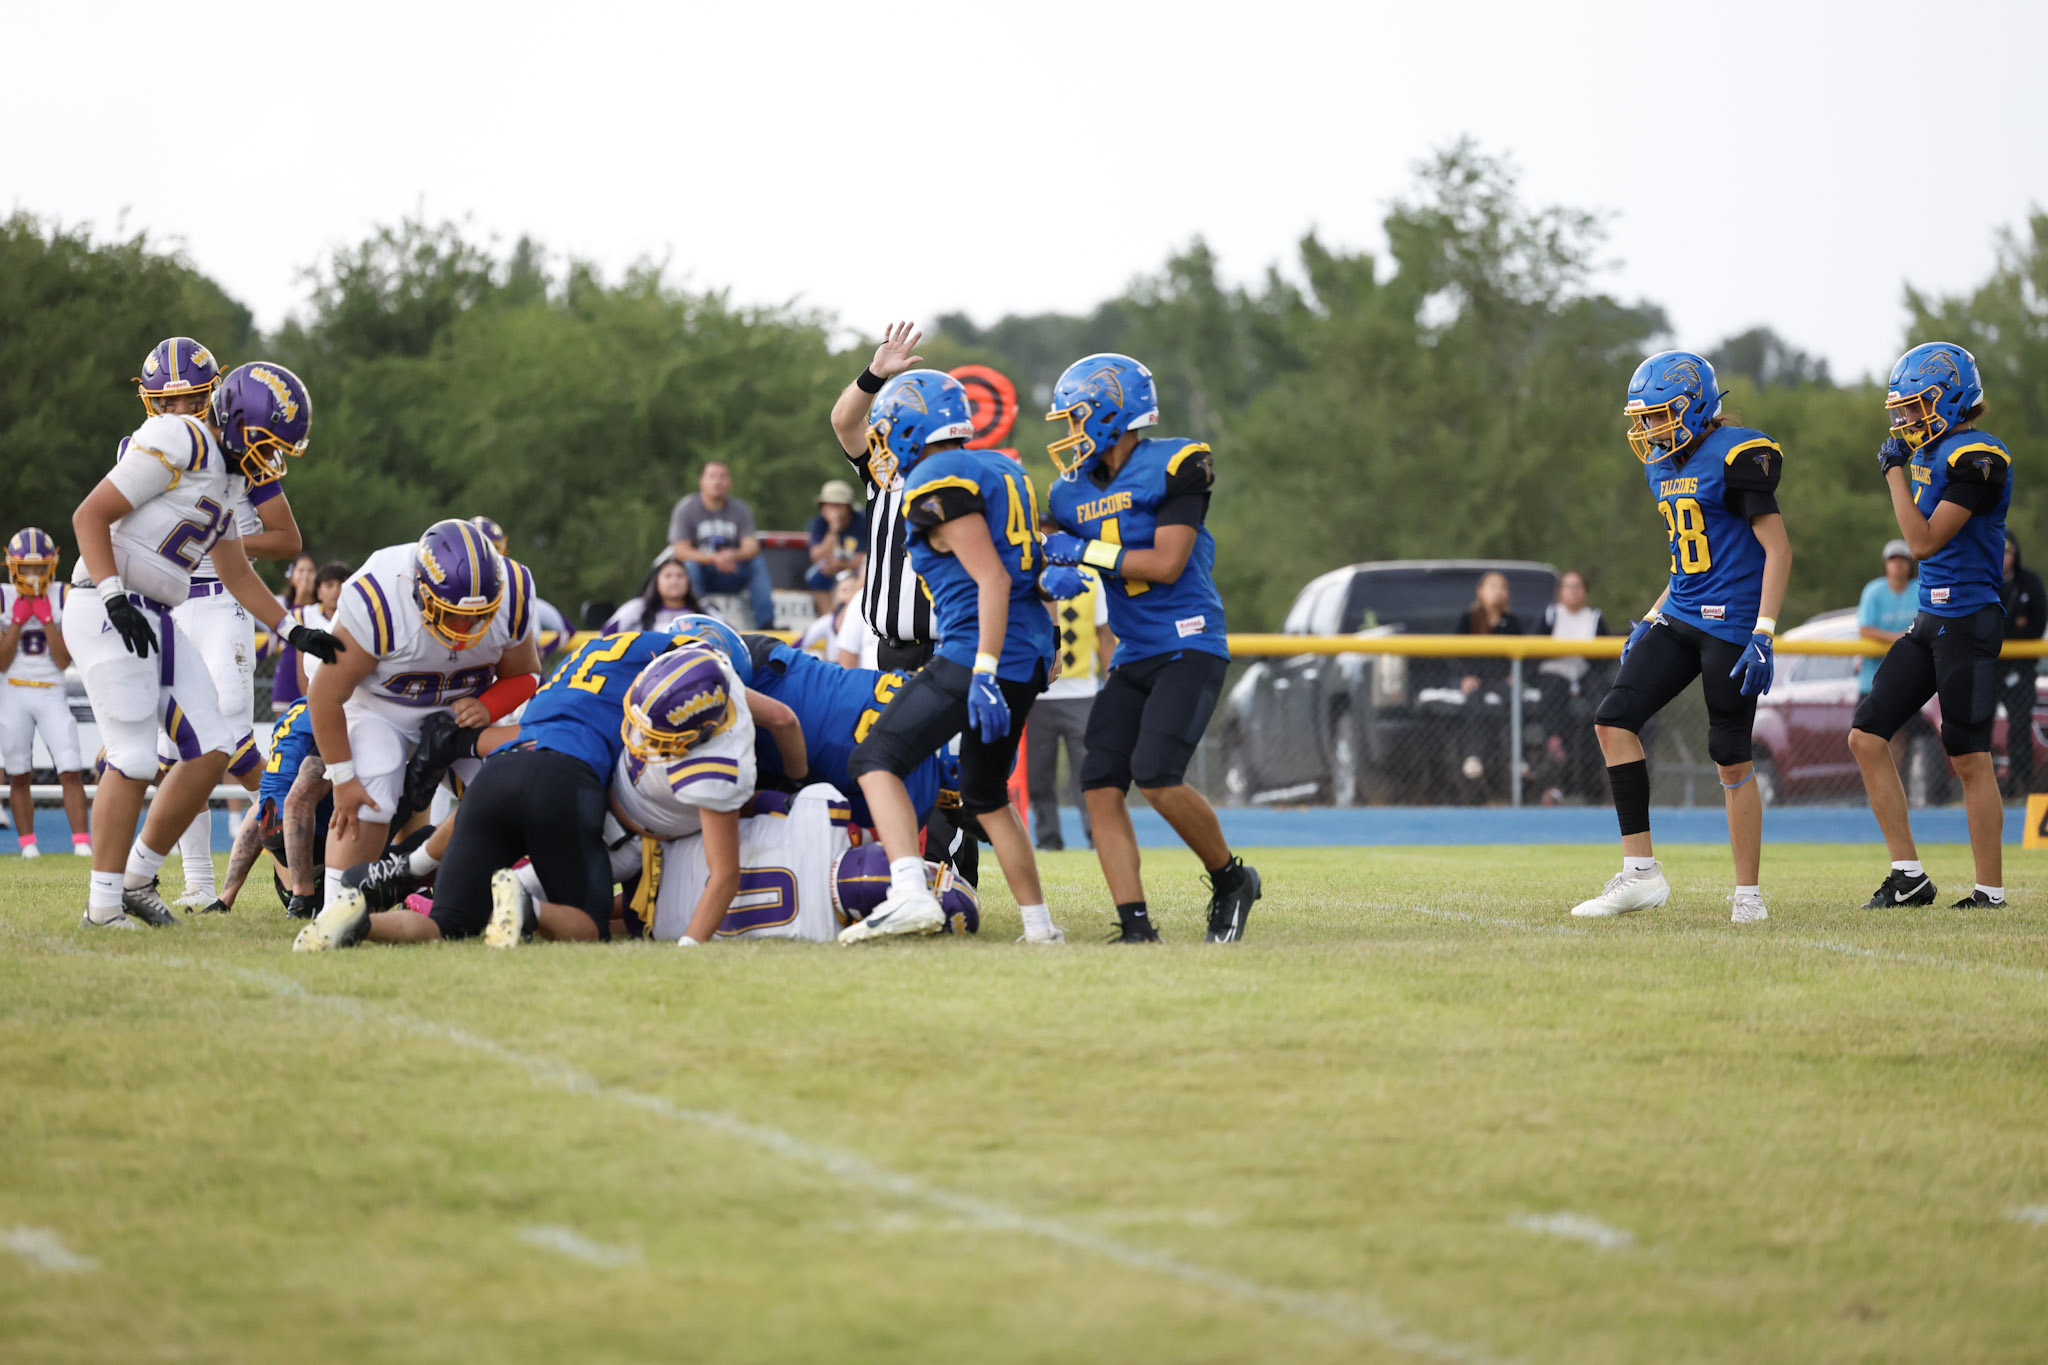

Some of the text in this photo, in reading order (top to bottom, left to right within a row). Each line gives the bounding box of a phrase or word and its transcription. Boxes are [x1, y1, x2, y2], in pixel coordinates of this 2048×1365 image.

[1660, 477, 1698, 497] FALCONS
[1076, 491, 1132, 524] FALCONS
[22, 630, 47, 655] 8
